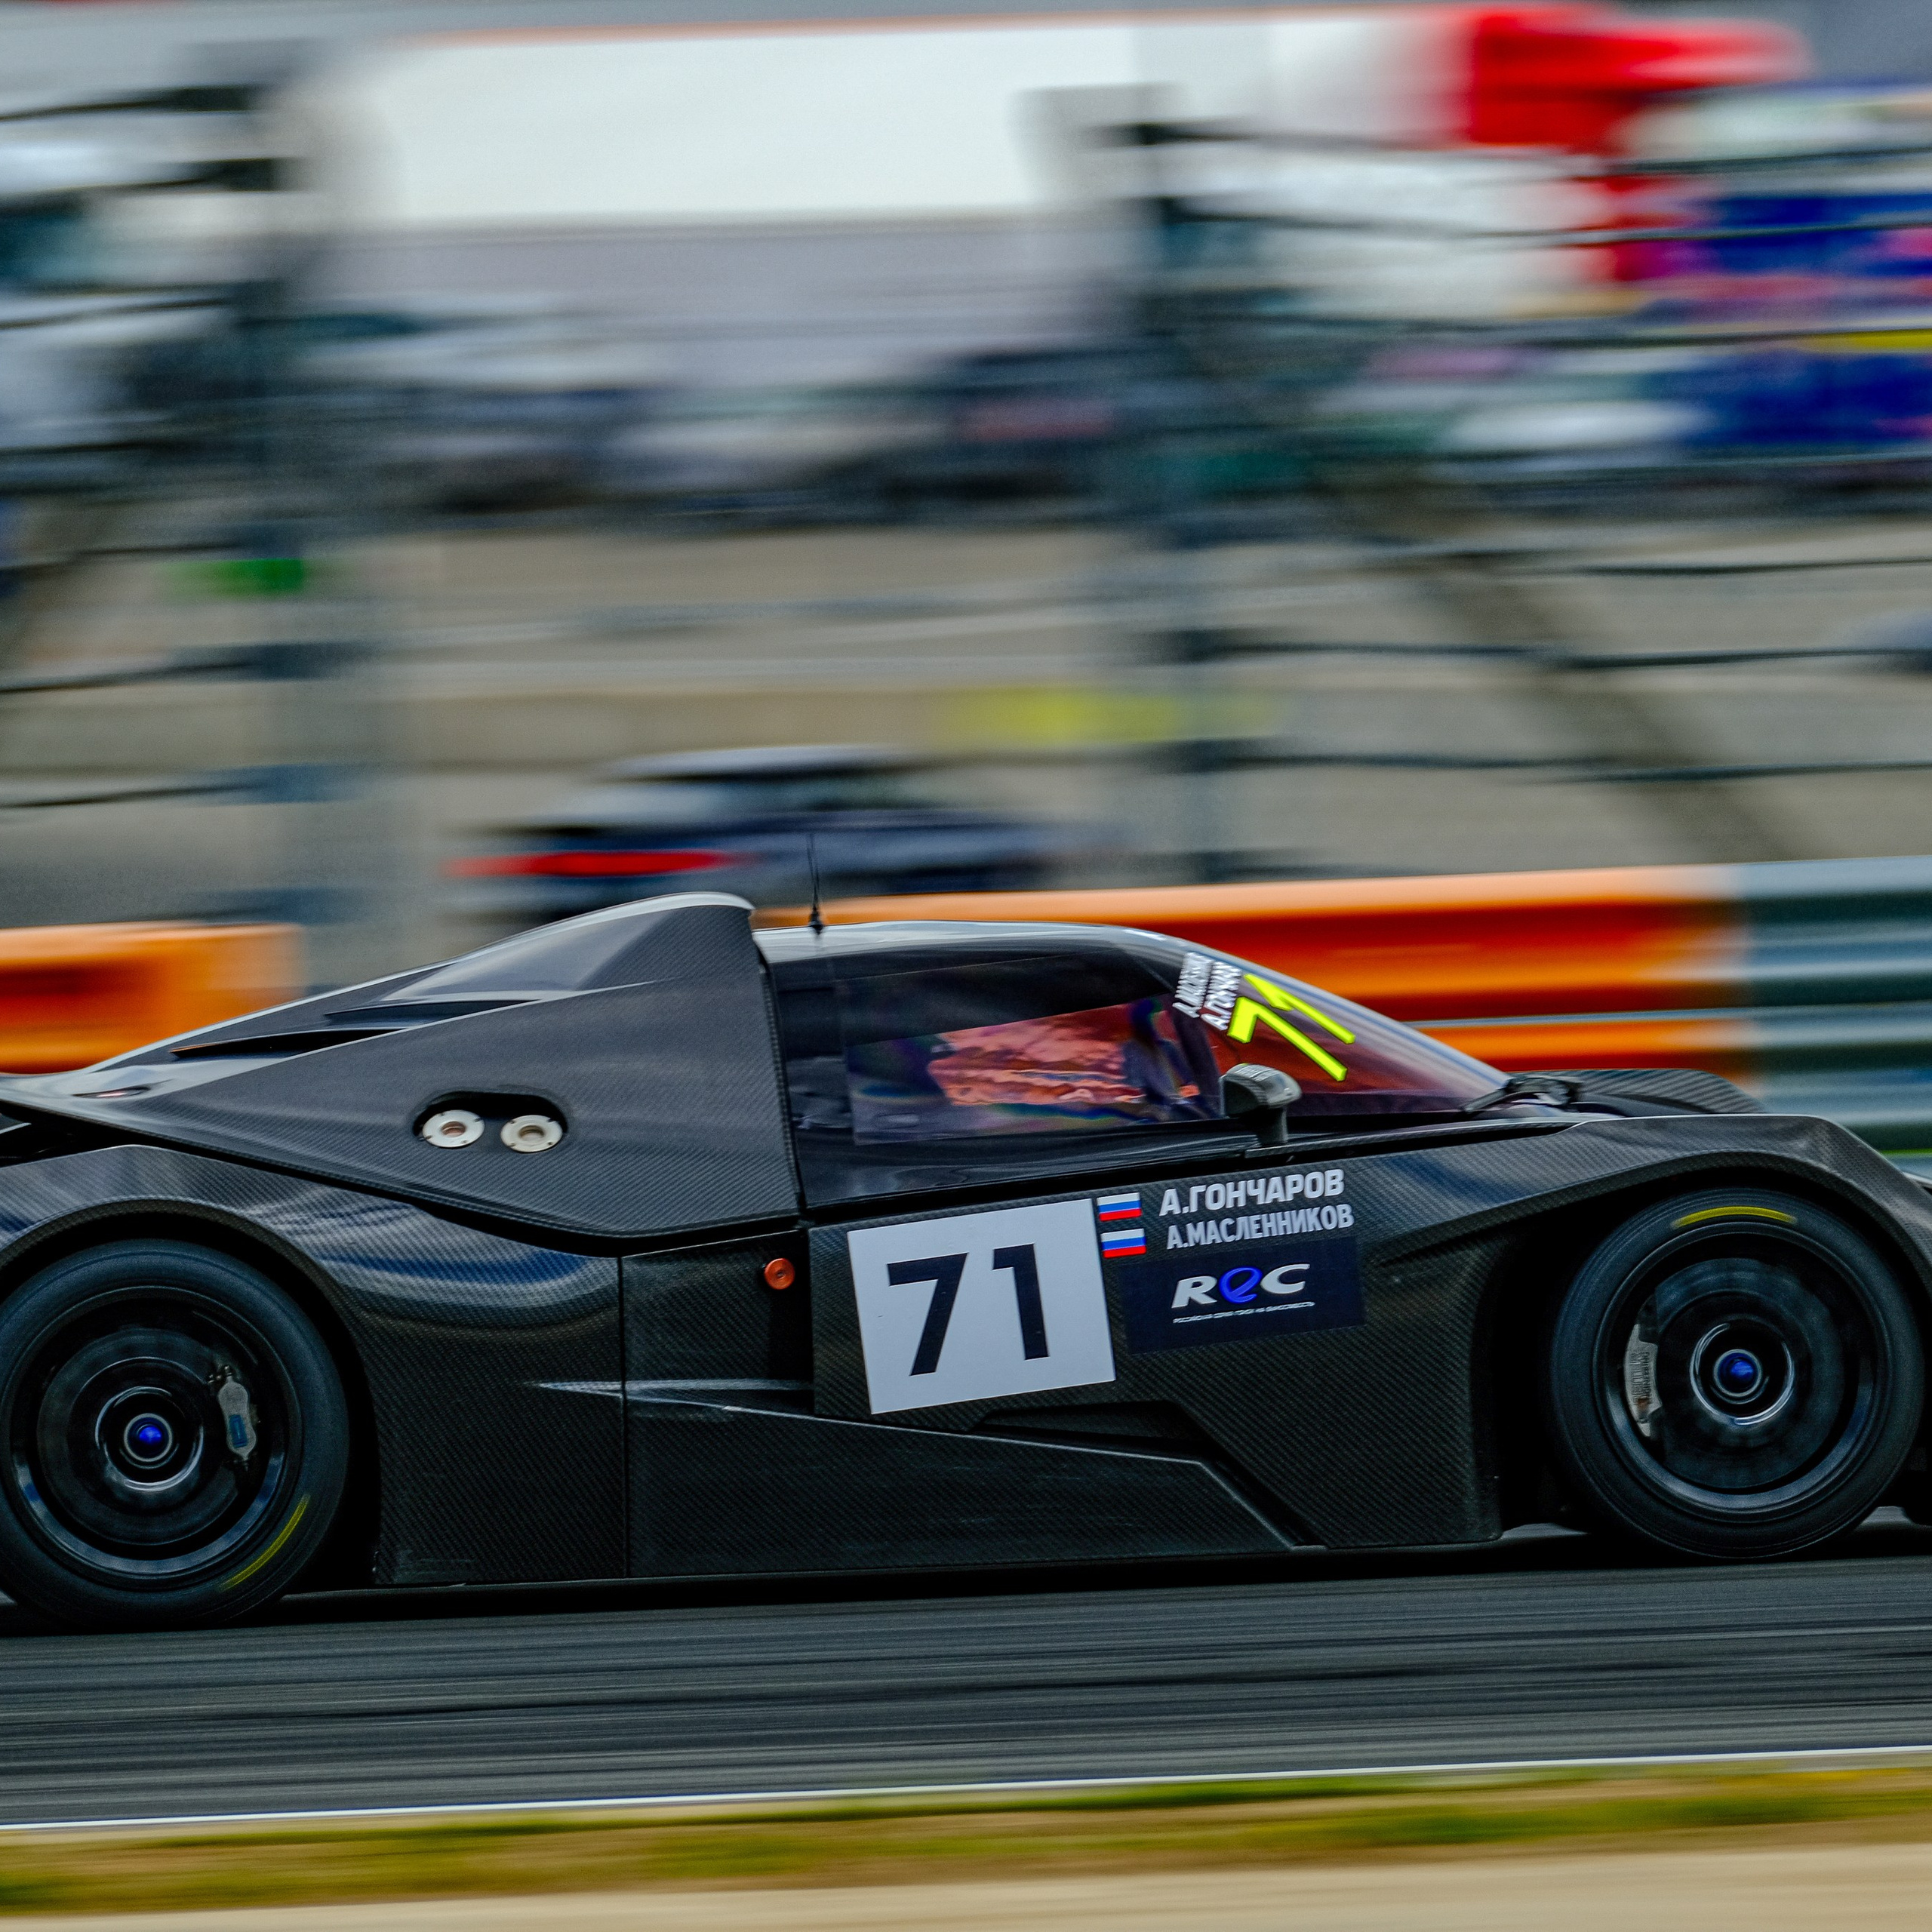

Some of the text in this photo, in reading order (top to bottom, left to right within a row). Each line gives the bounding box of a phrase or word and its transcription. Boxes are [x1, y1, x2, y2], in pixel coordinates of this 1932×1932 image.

[1227, 973, 1356, 1081] 71
[1158, 1169, 1345, 1217] А.ГОНЧАРОВ
[1166, 1204, 1355, 1250] А.МАСЛЕННИКОВ
[886, 1243, 1050, 1377] 71
